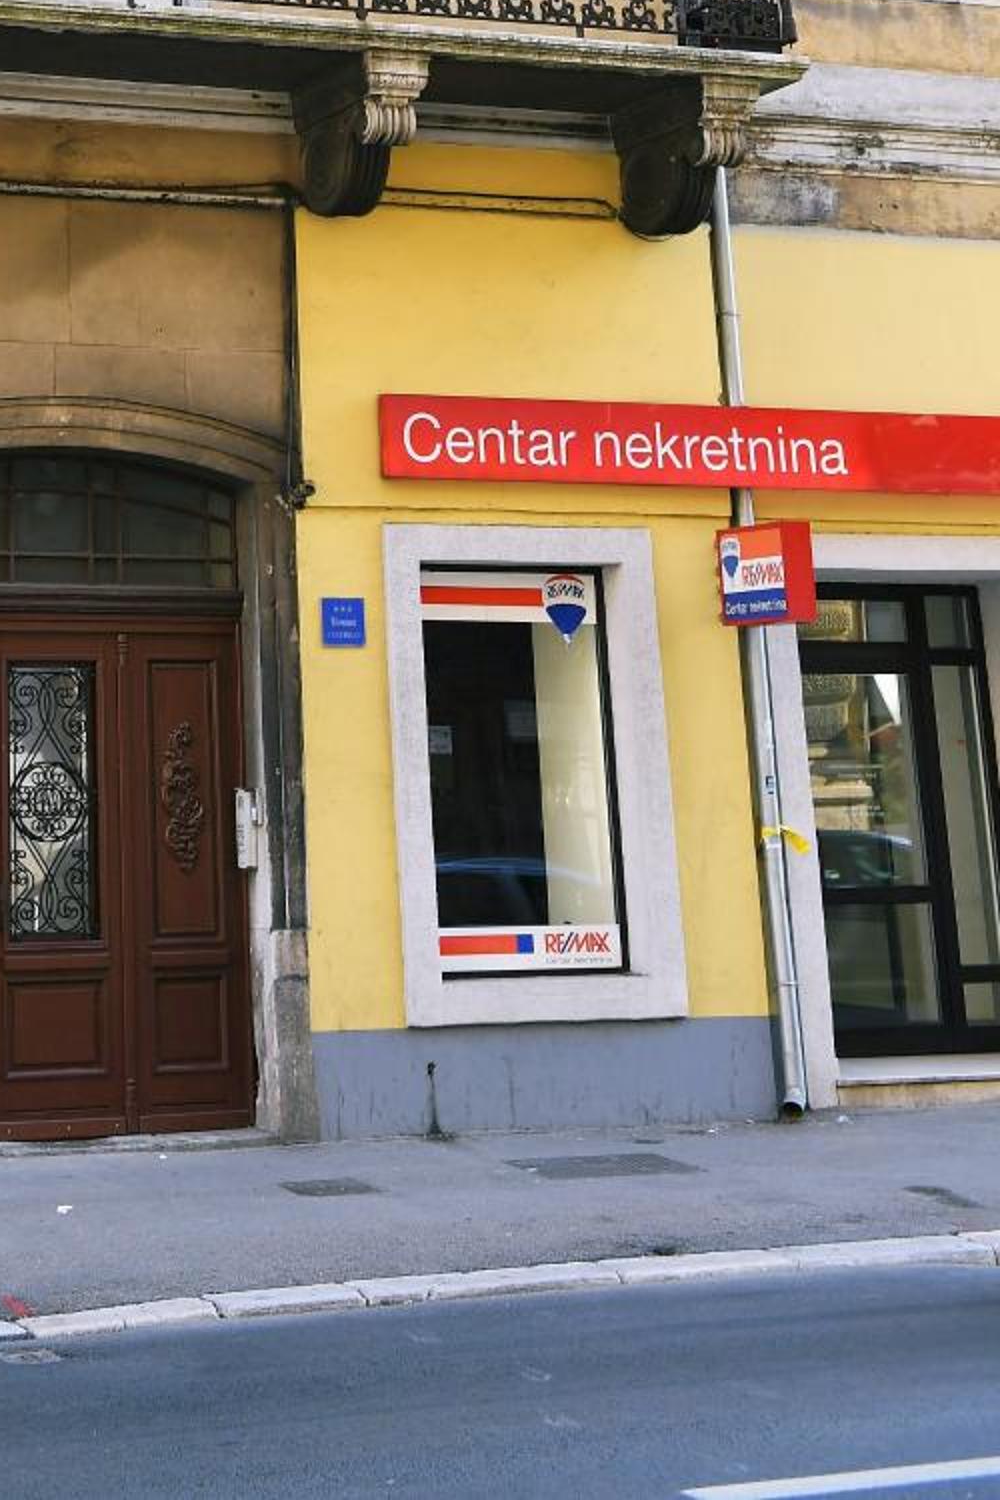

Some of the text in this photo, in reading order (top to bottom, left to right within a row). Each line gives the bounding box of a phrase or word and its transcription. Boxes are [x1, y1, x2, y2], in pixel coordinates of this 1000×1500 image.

[403, 412, 849, 476] Centar nekretnina
[545, 932, 612, 954] RE/MAX
